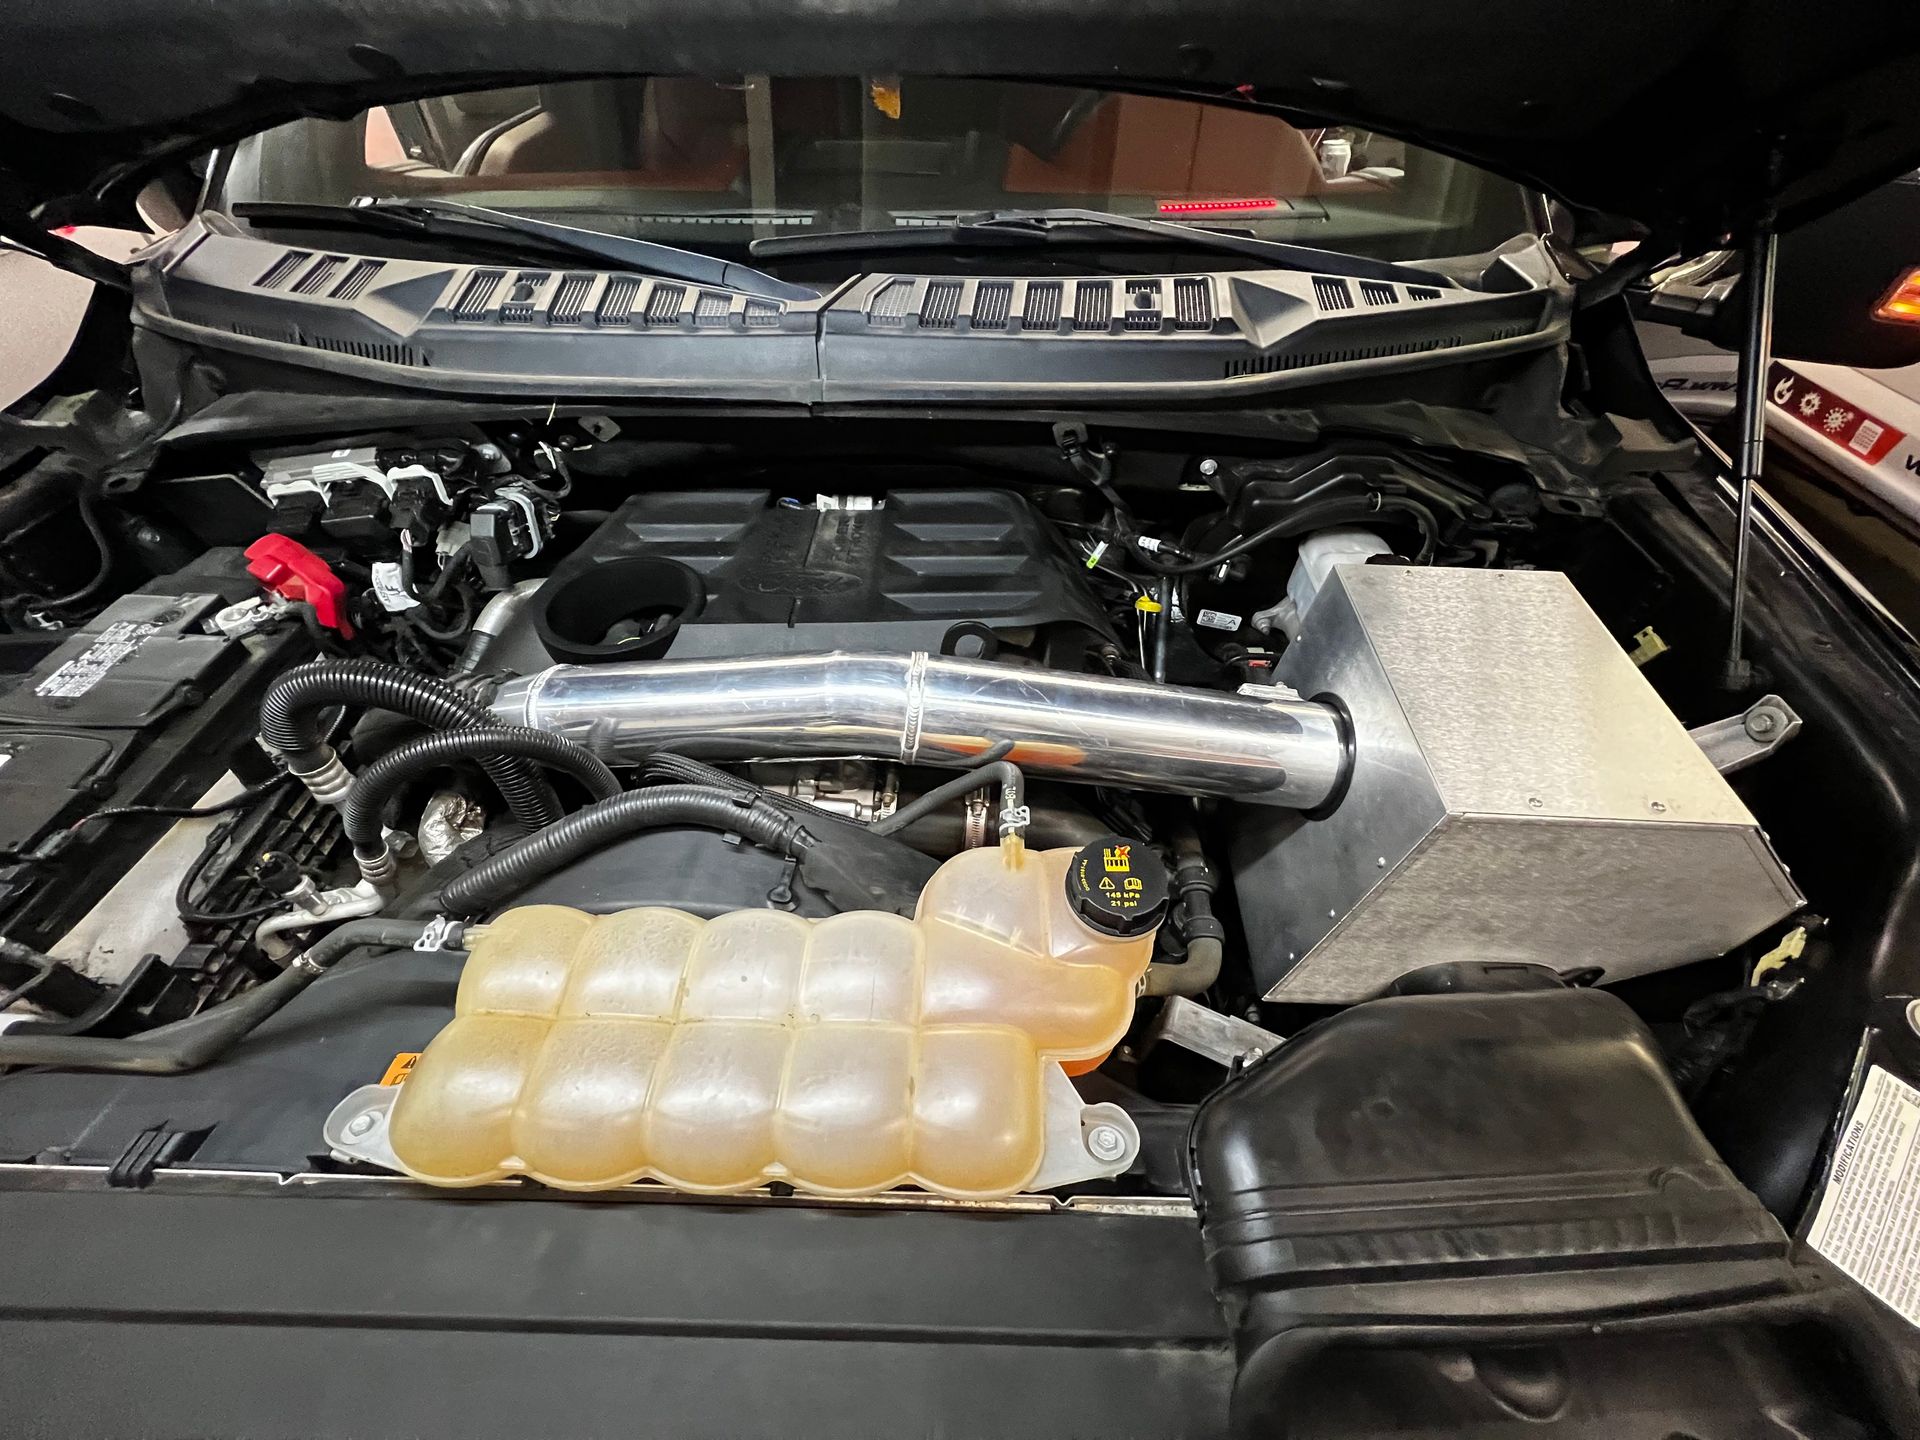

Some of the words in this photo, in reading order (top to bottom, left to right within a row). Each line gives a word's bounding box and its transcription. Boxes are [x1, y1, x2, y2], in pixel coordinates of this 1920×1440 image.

[1123, 891, 1140, 899] kPa
[1123, 900, 1138, 908] psi
[1832, 1120, 1865, 1185] MODIFICATIONS
